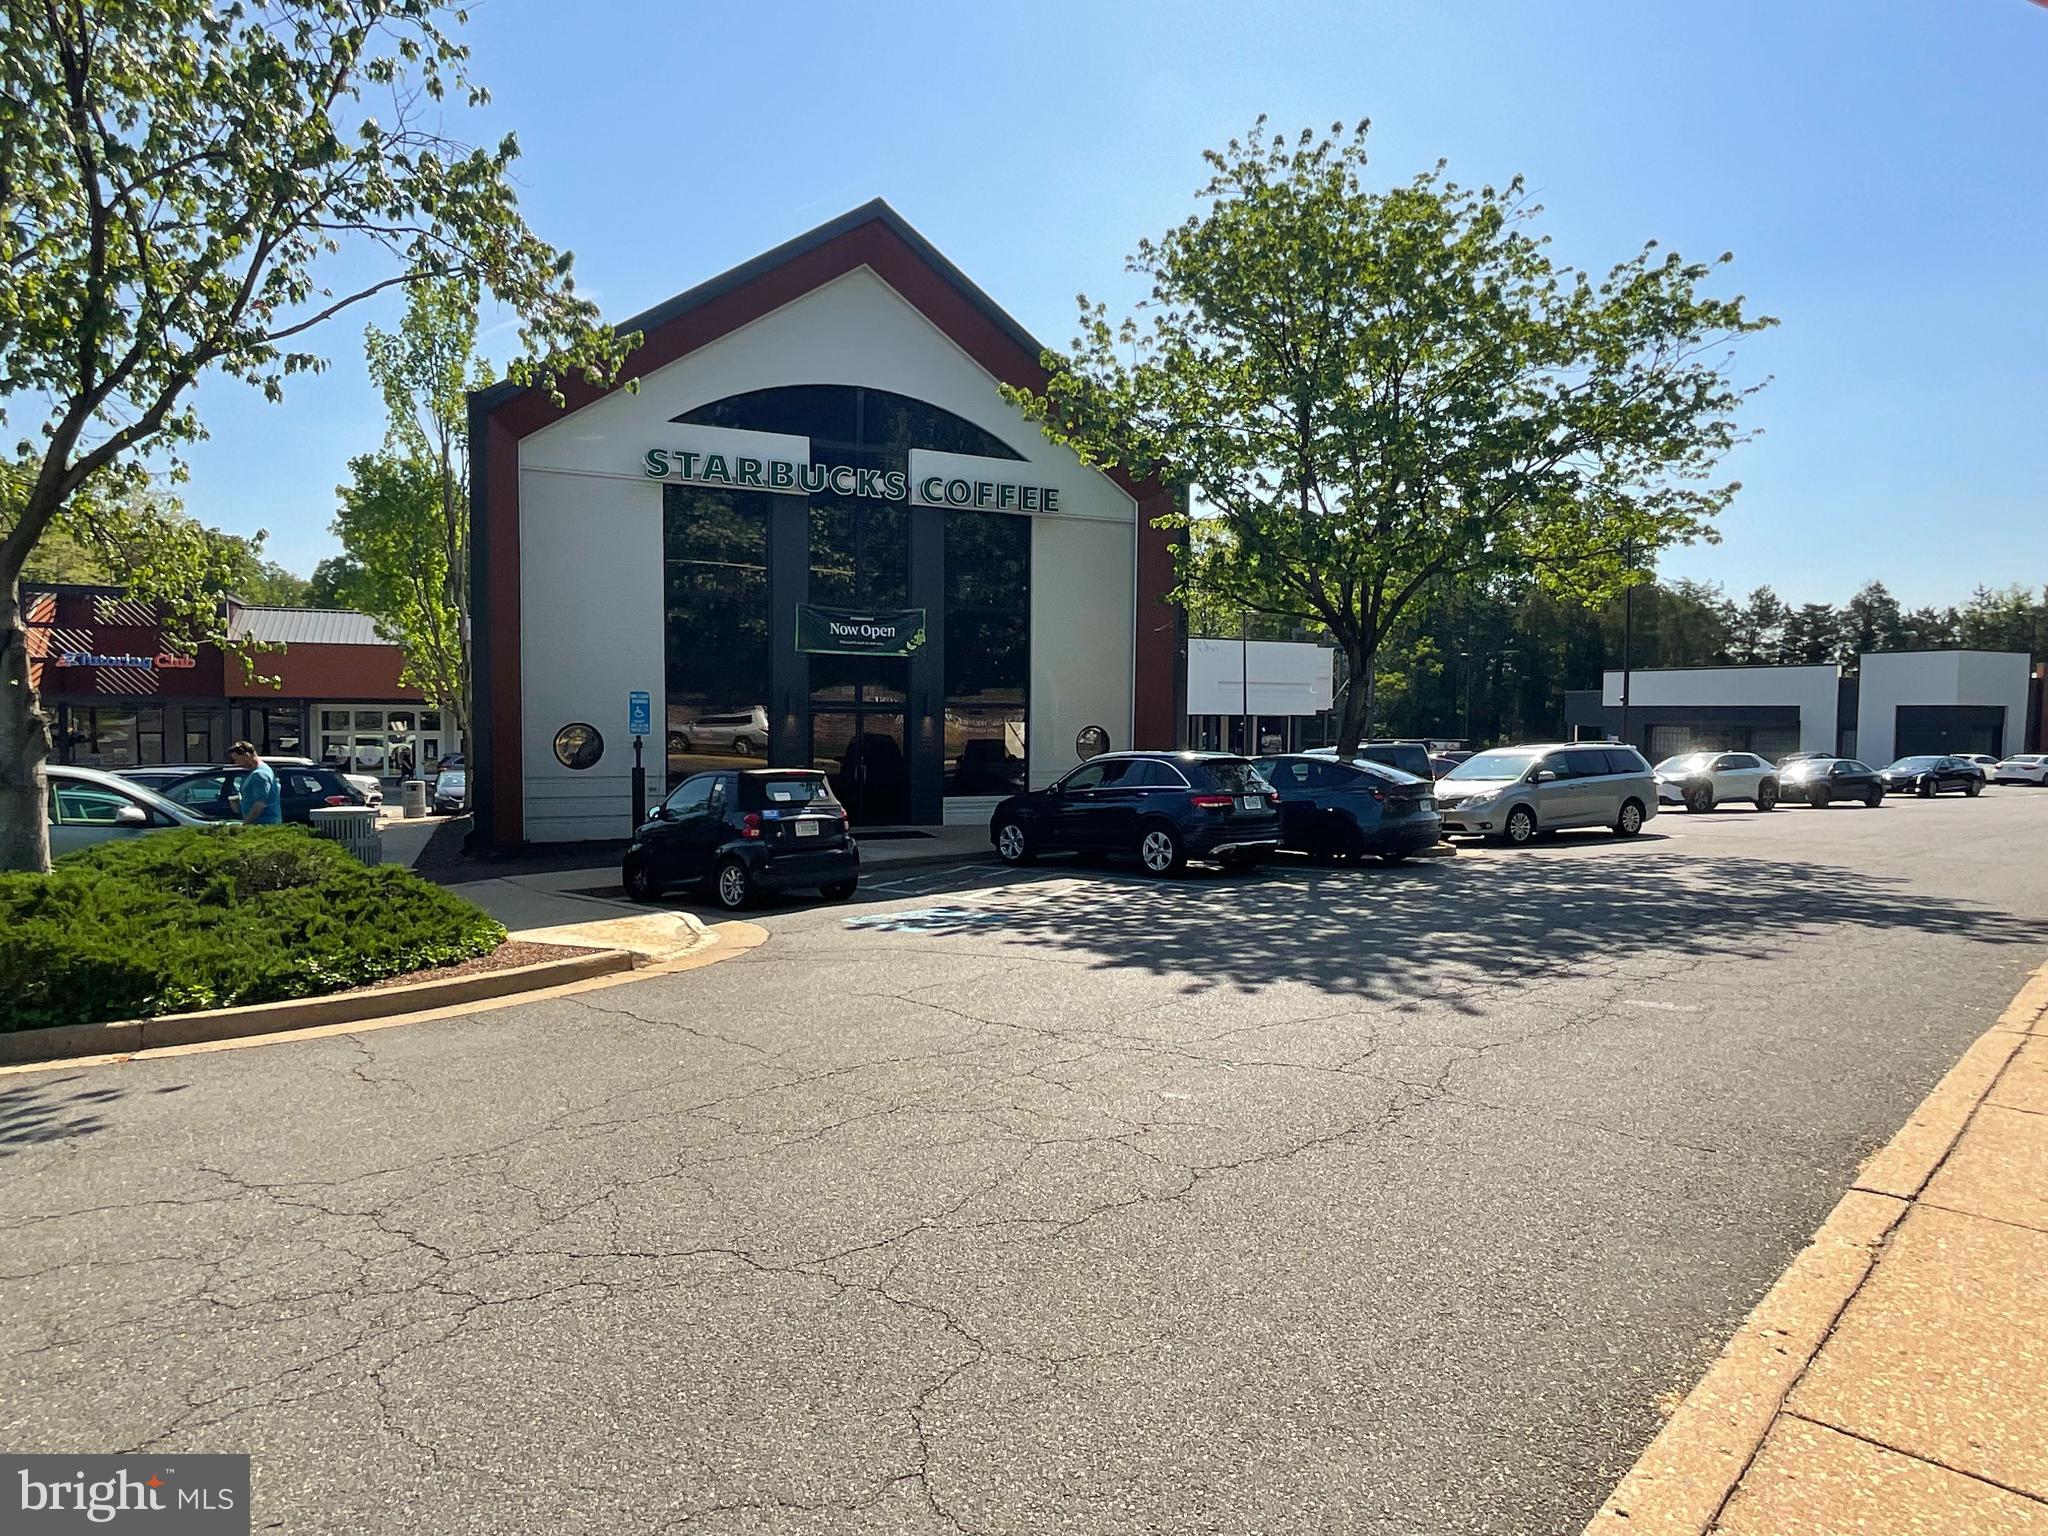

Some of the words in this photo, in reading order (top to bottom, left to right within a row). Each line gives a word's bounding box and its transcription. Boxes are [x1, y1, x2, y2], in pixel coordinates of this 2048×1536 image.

[645, 448, 907, 500] STARBUCKS
[920, 476, 1061, 513] COFFEE
[829, 622, 860, 636] Now
[860, 624, 896, 640] Open
[80, 652, 153, 670] Tutoring
[154, 652, 196, 669] Club
